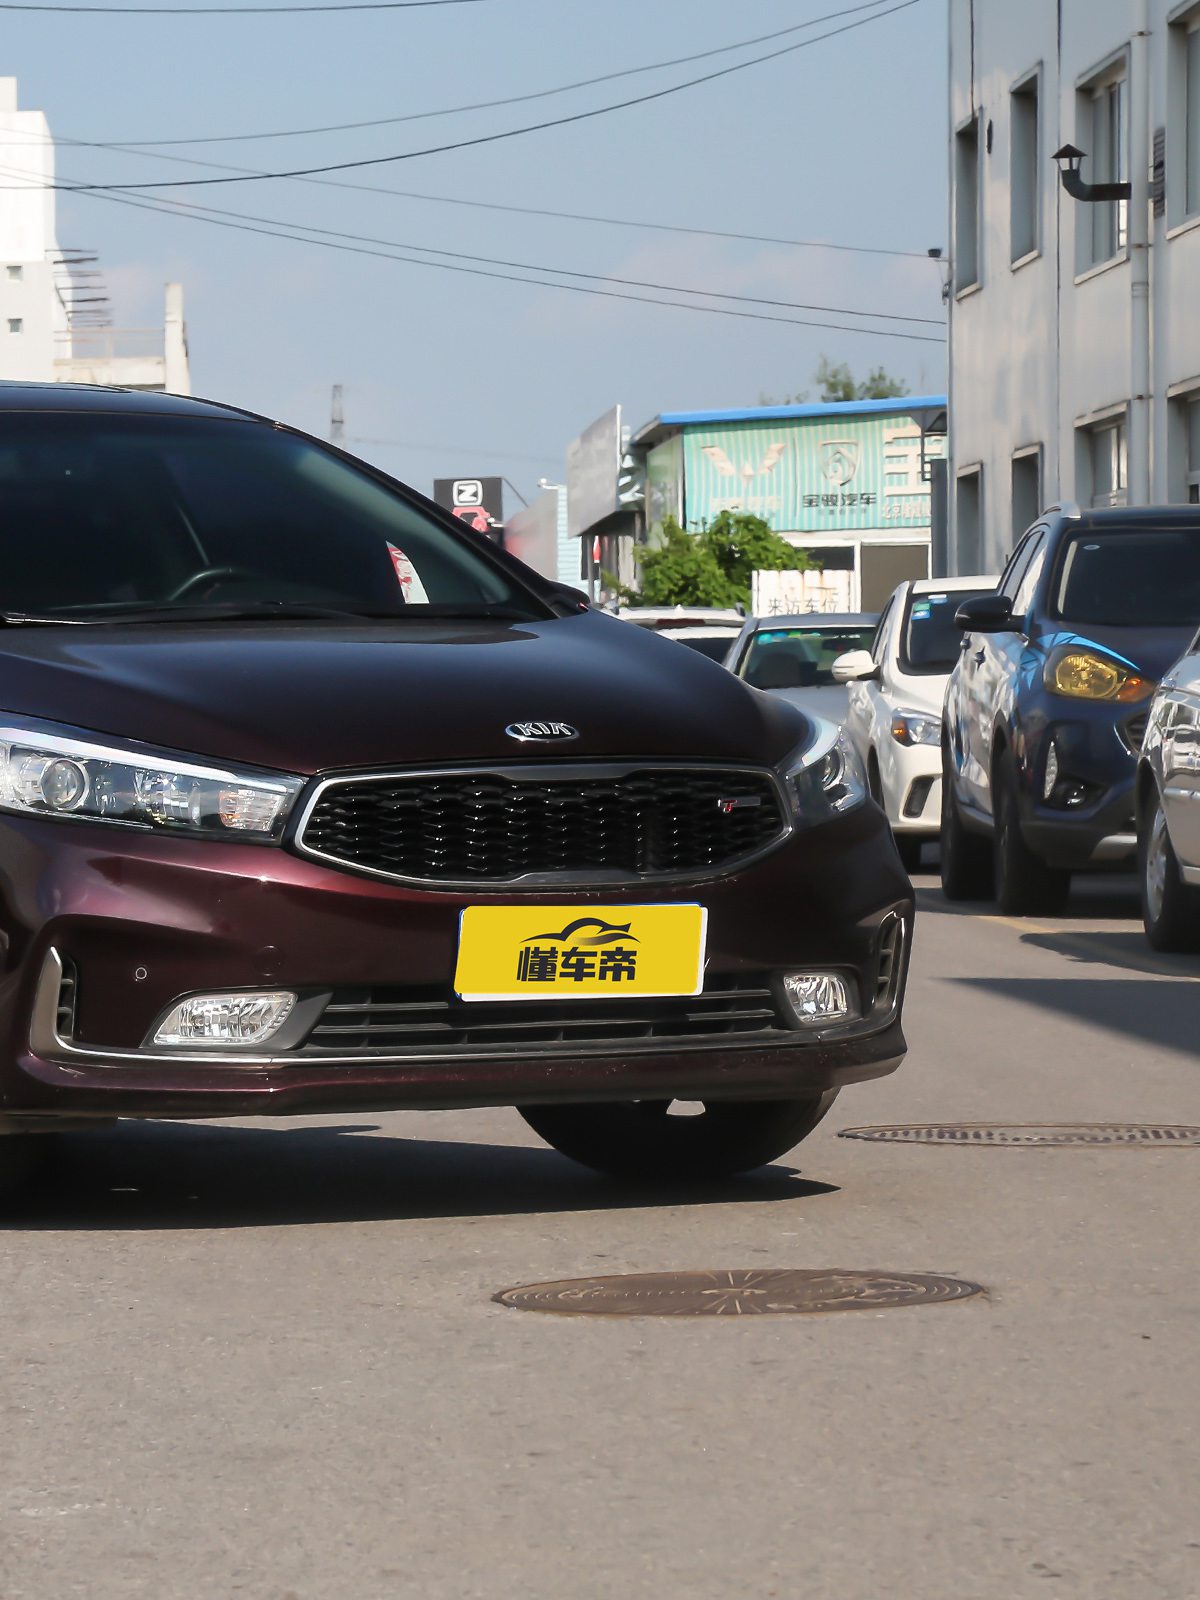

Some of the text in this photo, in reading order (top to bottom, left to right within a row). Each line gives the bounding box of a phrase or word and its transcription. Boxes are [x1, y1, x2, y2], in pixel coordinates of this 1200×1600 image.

[803, 492, 877, 507] 宝骏汽车
[514, 722, 572, 736] KIA
